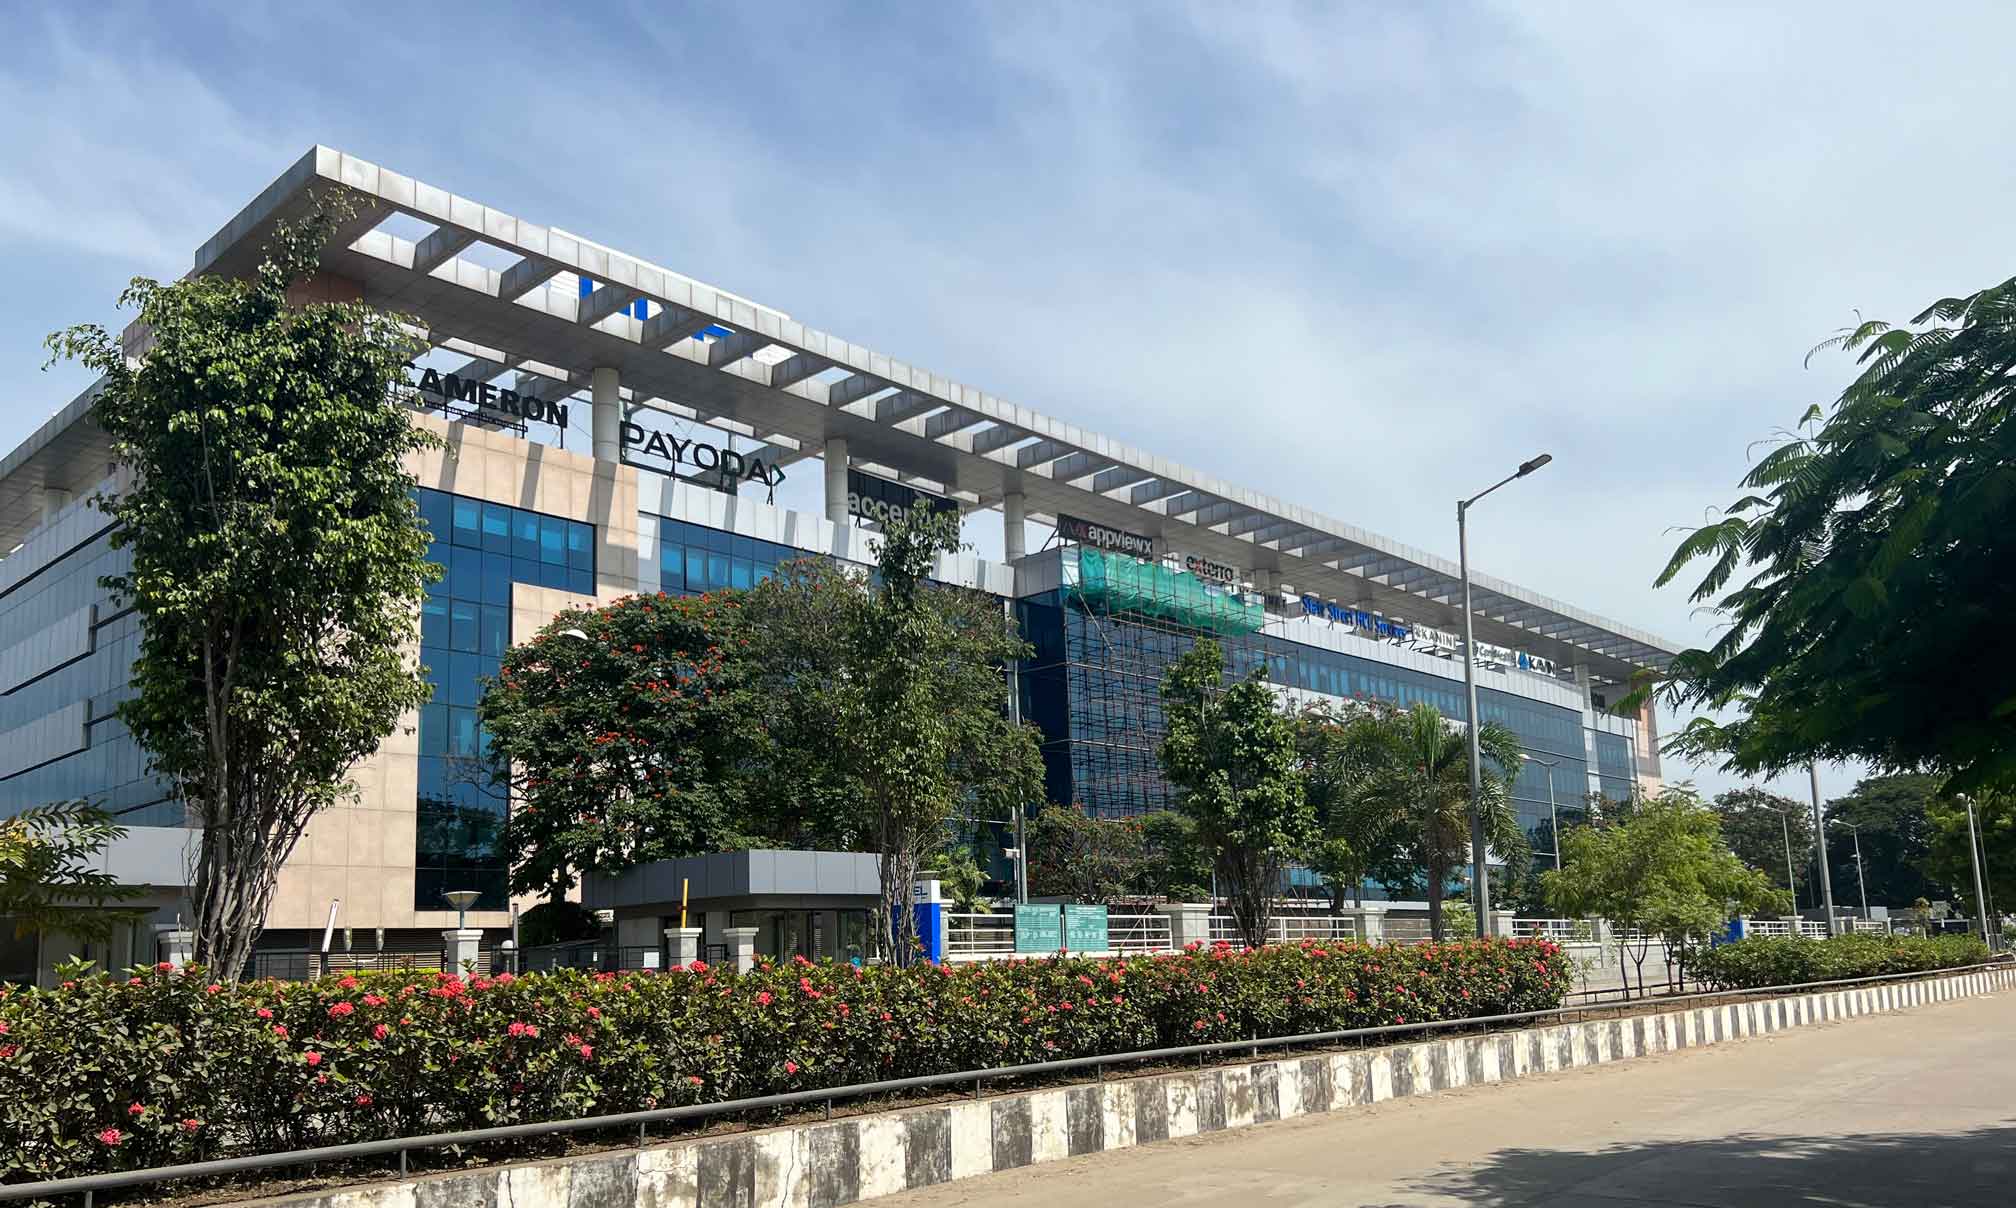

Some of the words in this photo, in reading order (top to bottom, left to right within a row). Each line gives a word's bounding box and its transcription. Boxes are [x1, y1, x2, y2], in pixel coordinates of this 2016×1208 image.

[620, 421, 774, 487] PAYODA
[1088, 525, 1152, 553] appviewx
[1186, 555, 1233, 582] exterro
